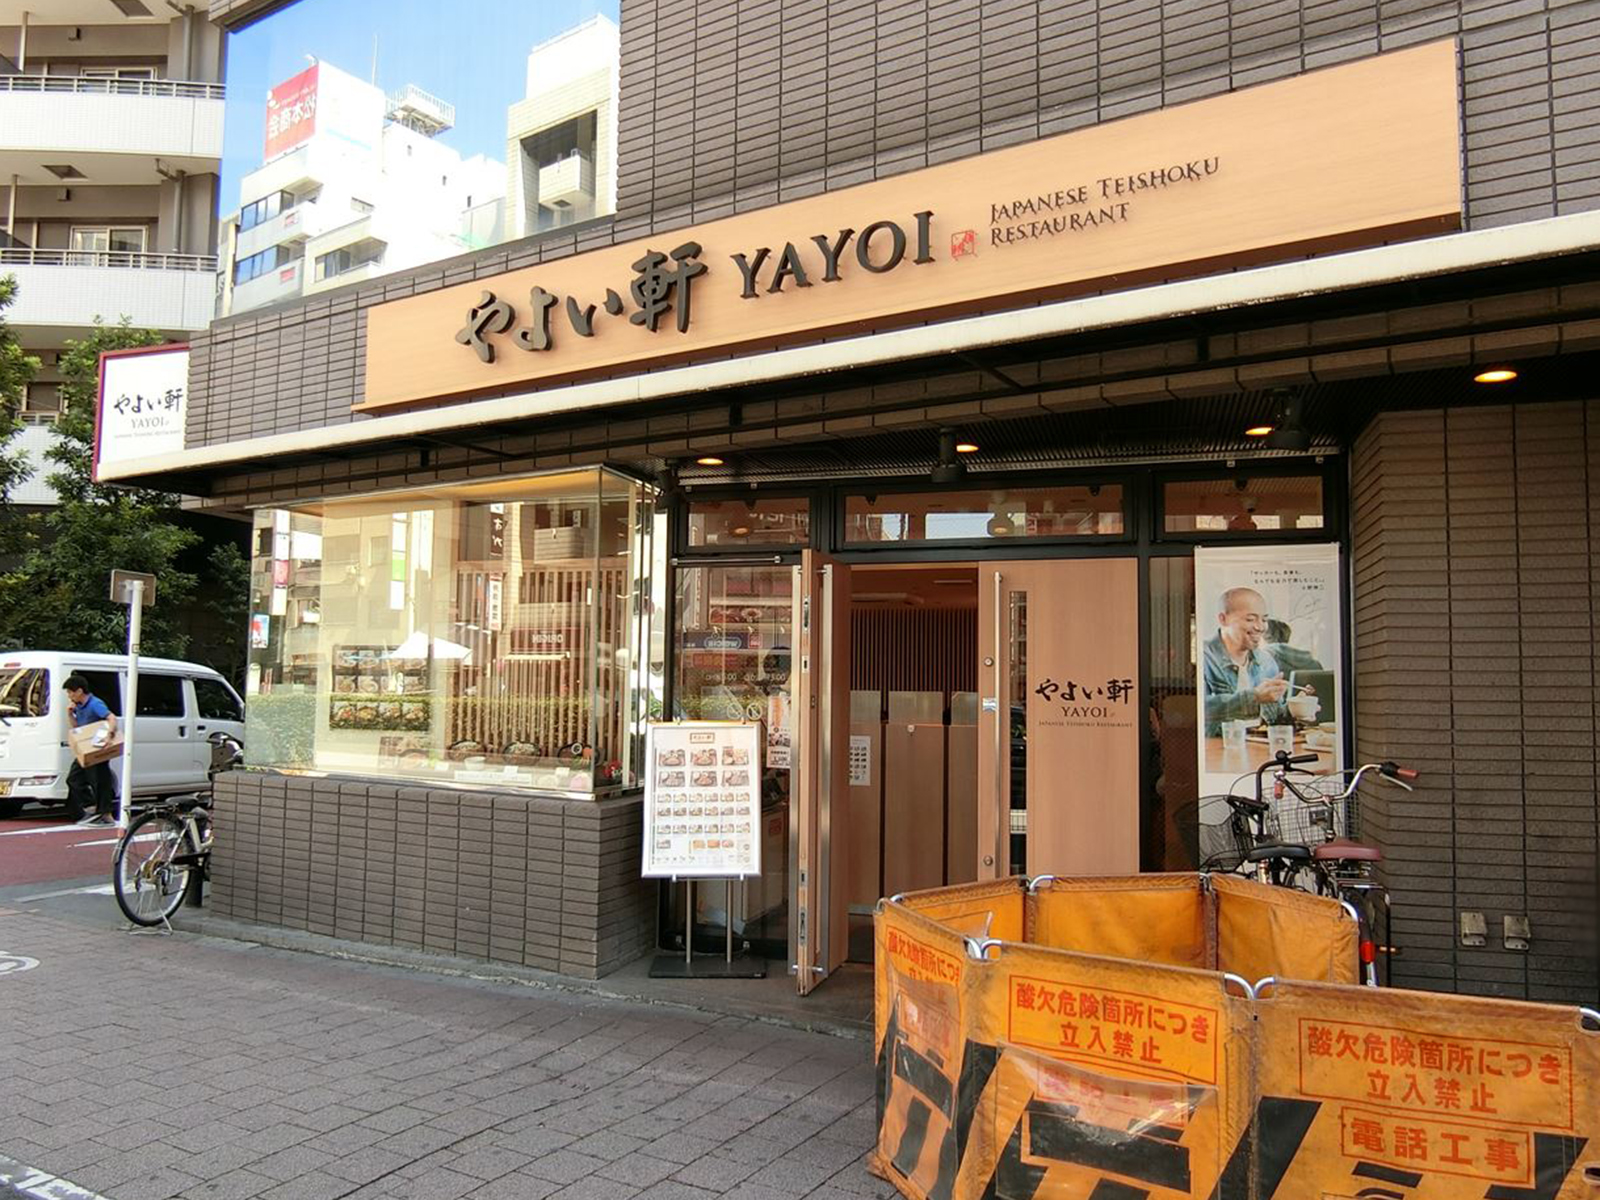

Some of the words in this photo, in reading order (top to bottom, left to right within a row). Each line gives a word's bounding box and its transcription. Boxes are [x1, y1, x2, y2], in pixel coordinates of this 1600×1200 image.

[990, 185, 1088, 225] JAPANESE
[1097, 156, 1220, 198] TEISHOKU
[990, 202, 1130, 247] RESTAURANT
[731, 210, 935, 299] YAYOI
[455, 240, 709, 364] やよい軒
[114, 388, 183, 415] やよい軒
[131, 416, 164, 429] YAYOI
[1035, 678, 1134, 705] やよい軒
[1061, 706, 1108, 718] YAYOI
[1016, 982, 1210, 1044] 酸欠危険箇所につき
[1060, 1021, 1162, 1064] 立入禁止
[1307, 1025, 1562, 1085] 酸欠危険箇所につき
[1366, 1069, 1498, 1115] 立入禁止
[1351, 1117, 1521, 1172] 電話工事
